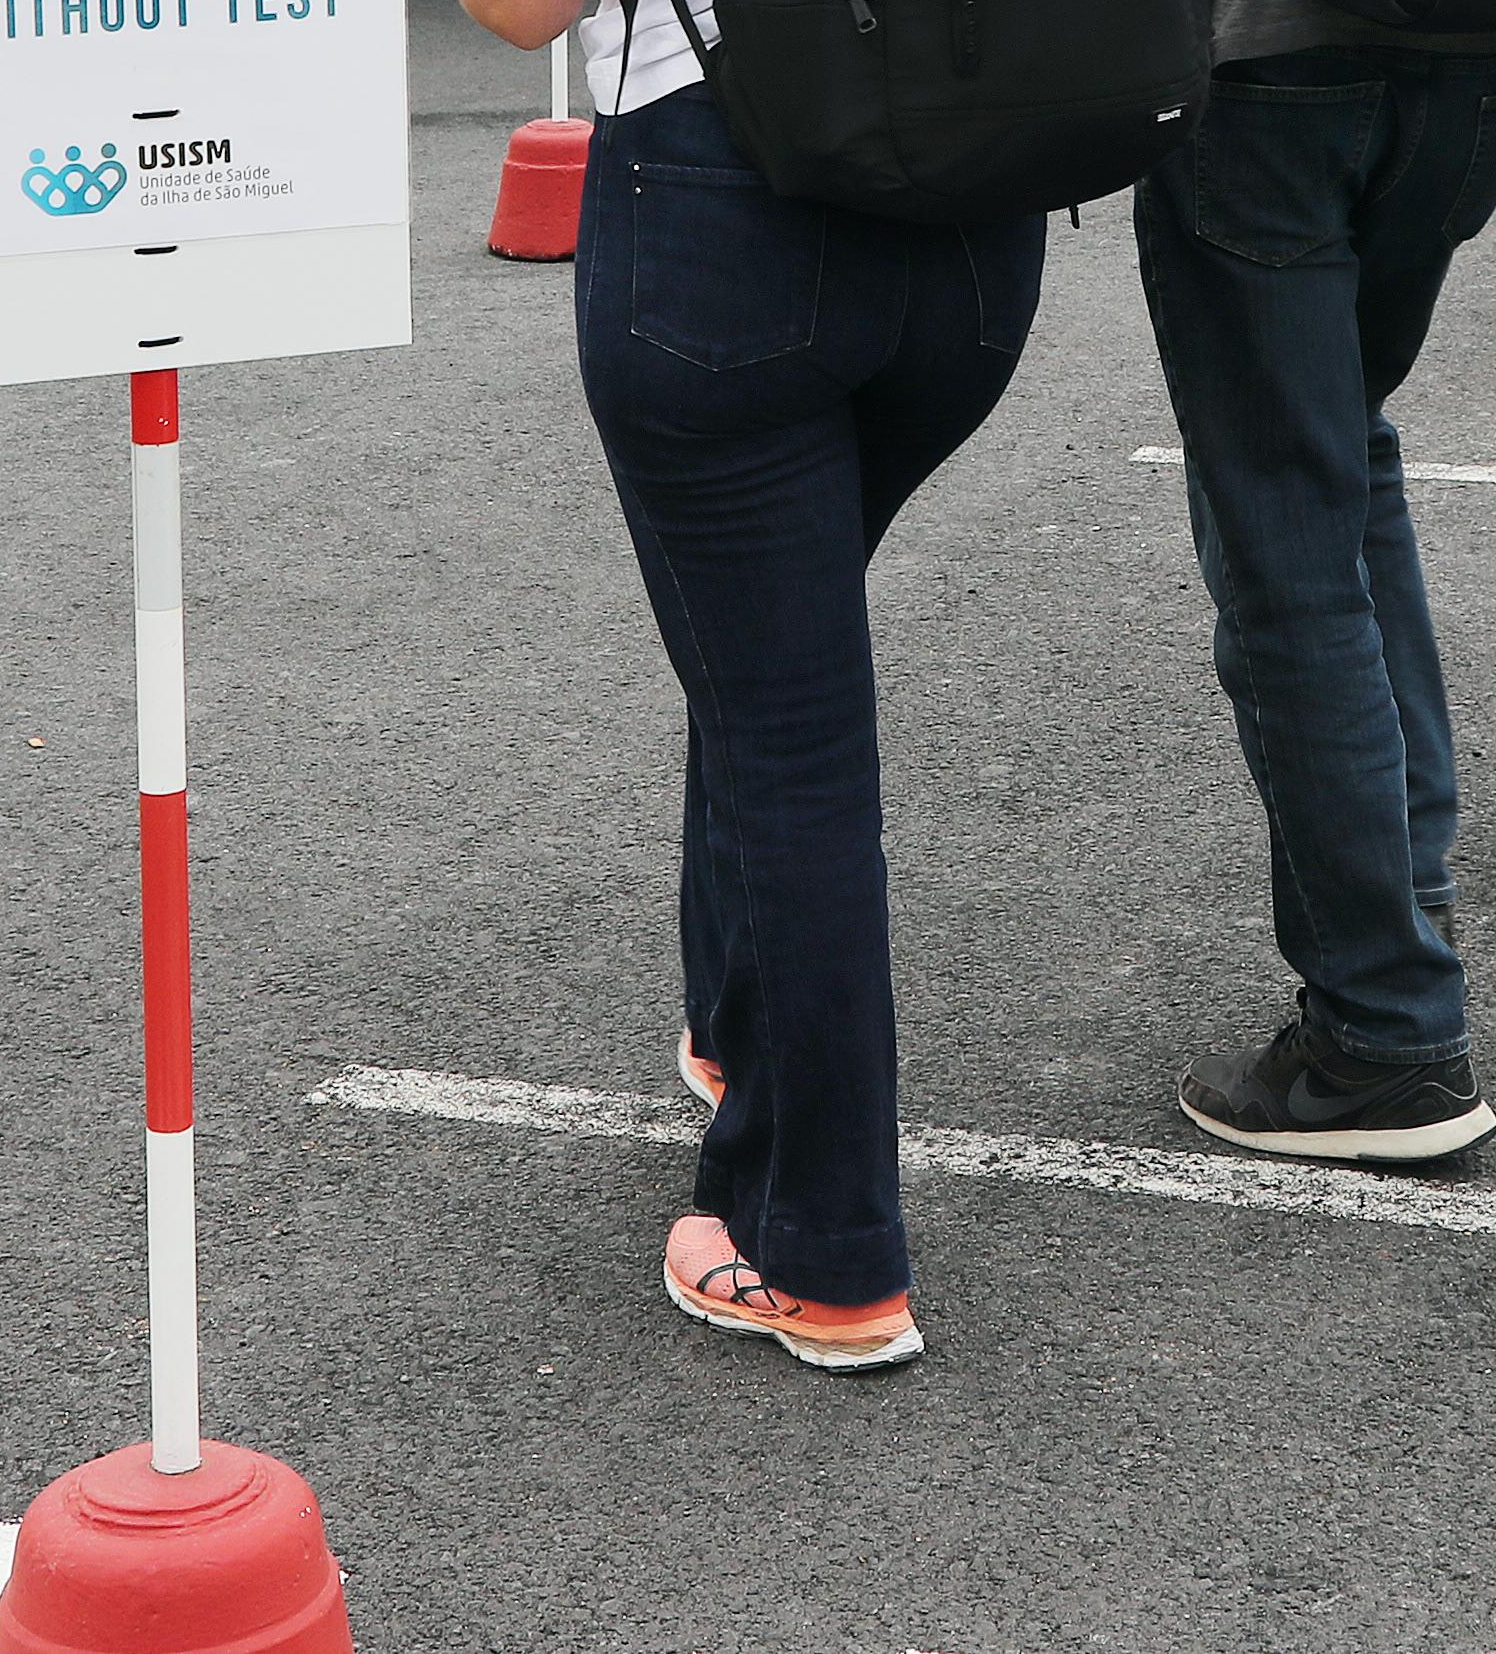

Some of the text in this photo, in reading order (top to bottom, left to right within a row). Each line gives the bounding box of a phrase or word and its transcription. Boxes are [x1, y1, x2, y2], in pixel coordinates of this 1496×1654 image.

[138, 138, 231, 170] USISM
[139, 164, 271, 190] Unidade de Saúde
[140, 180, 294, 207] da Ilha de São Miguel
